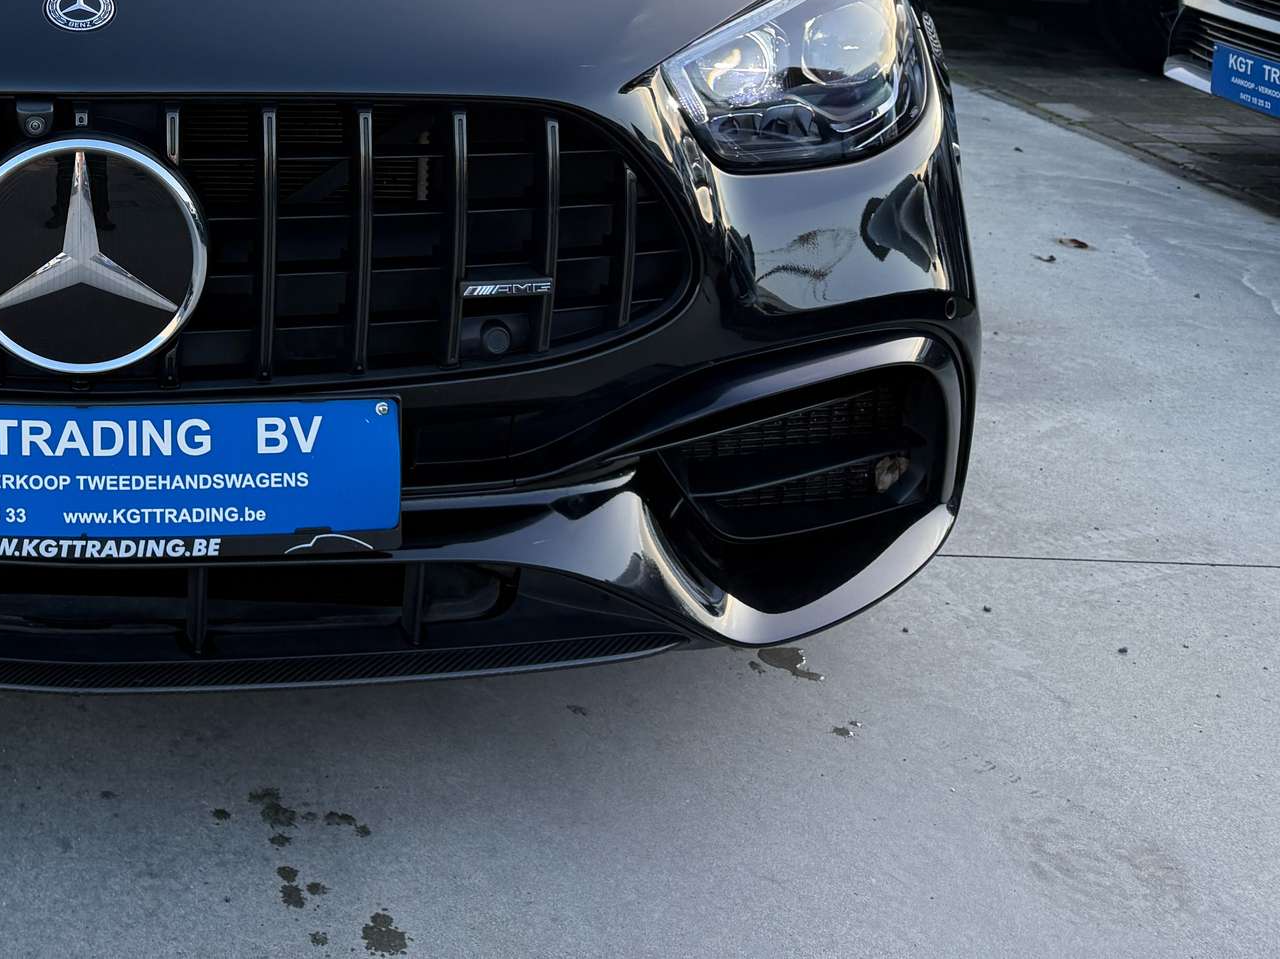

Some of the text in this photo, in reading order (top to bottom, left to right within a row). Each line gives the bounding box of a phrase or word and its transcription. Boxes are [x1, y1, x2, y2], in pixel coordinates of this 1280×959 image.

[1228, 53, 1280, 85] KGT TR
[491, 282, 551, 295] AMG
[256, 415, 323, 454] BV
[75, 471, 309, 491] TWEEDEHANDSWAGENS
[5, 506, 27, 523] 33
[63, 506, 266, 524] www.KGTTRADING.be
